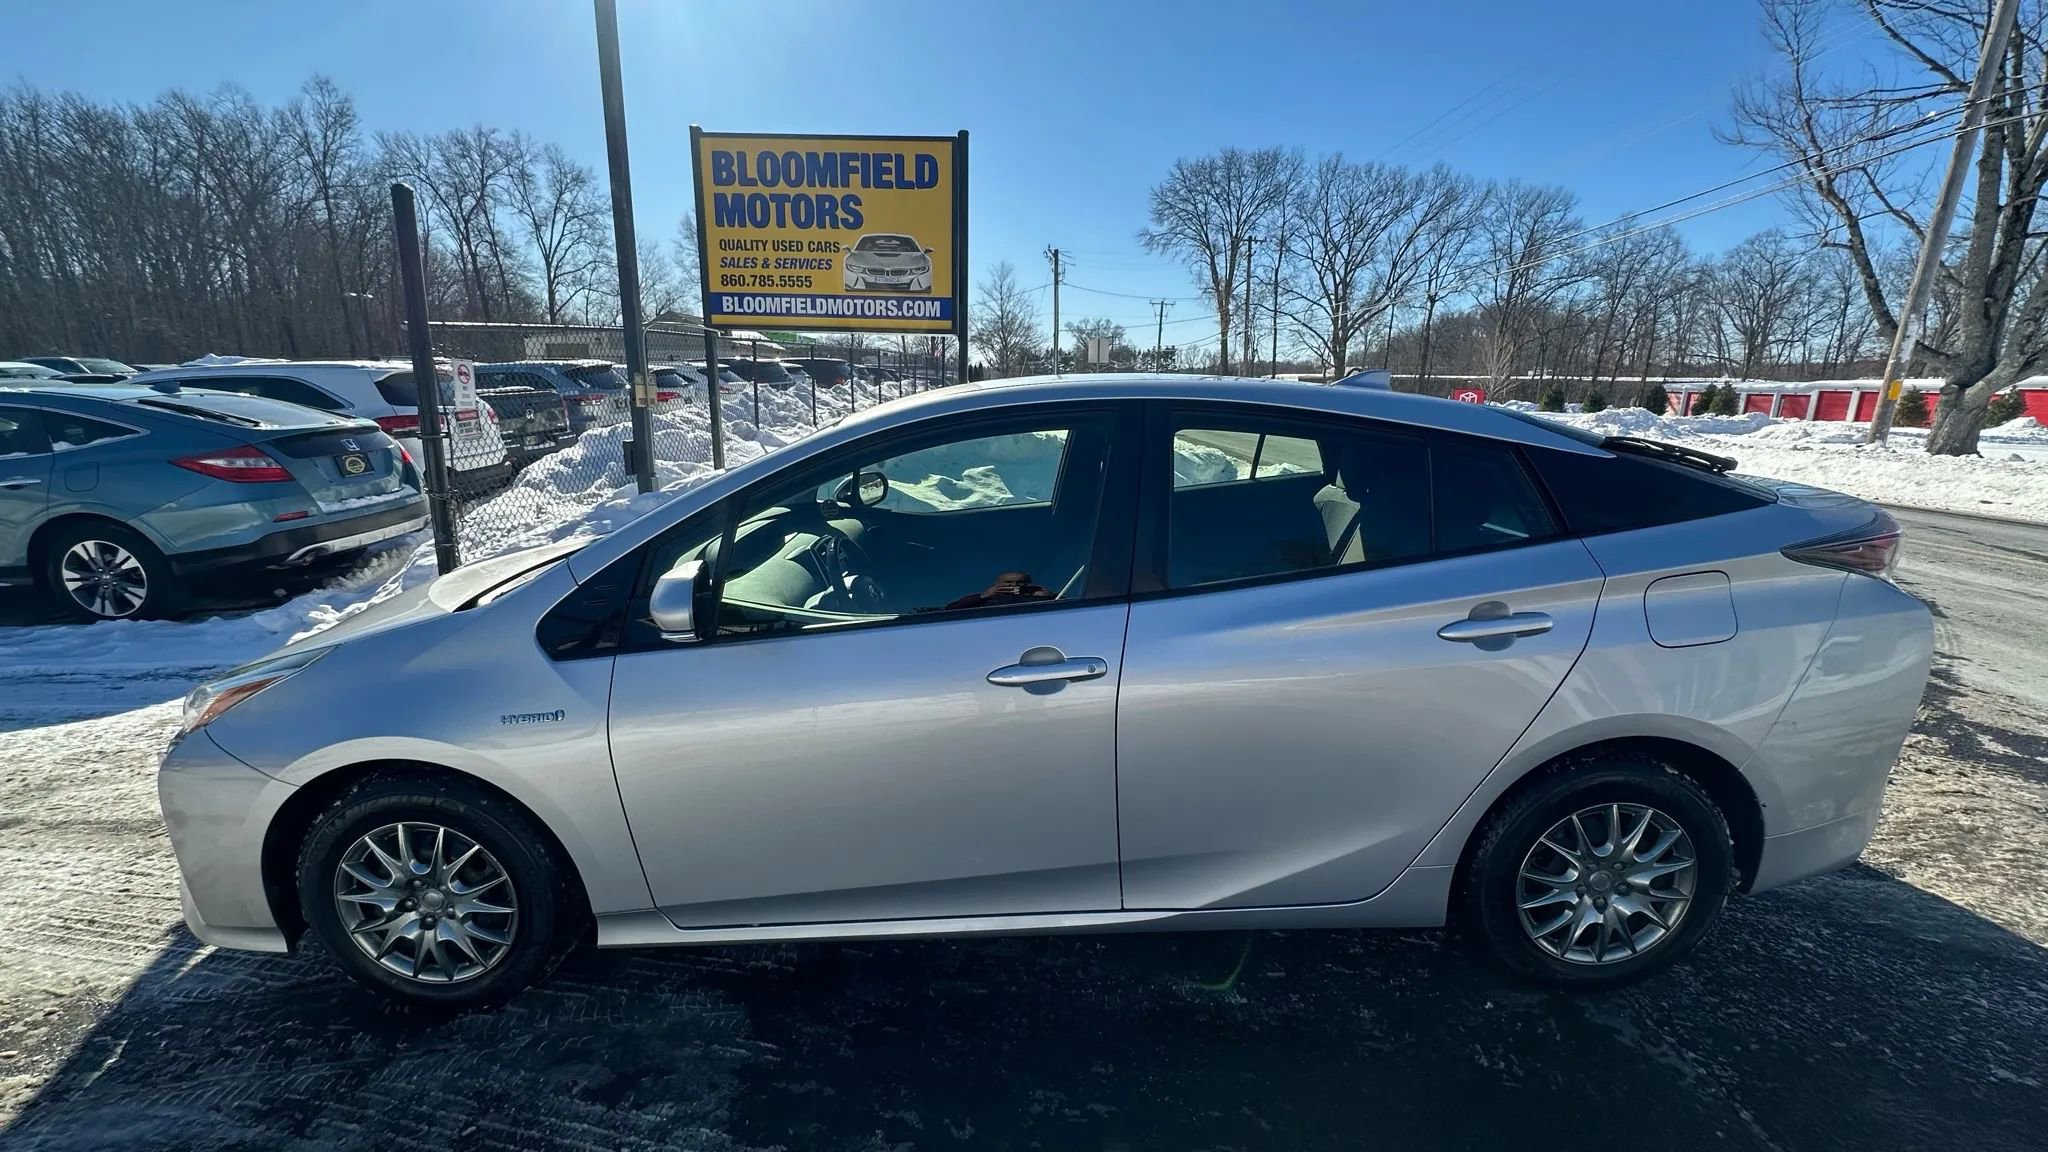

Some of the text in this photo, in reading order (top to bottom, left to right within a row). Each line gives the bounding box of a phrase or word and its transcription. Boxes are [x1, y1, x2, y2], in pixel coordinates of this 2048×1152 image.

[711, 150, 939, 190] BLOOMFIELD
[713, 192, 864, 230] MOTORS
[719, 238, 841, 254] QUALITY USED CARS
[719, 256, 833, 271] SALES & SERVICES
[720, 274, 813, 289] 860.785.5555
[721, 295, 941, 318] BLOOMFIELDMOTORS.COM
[500, 711, 555, 725] HYBRID
